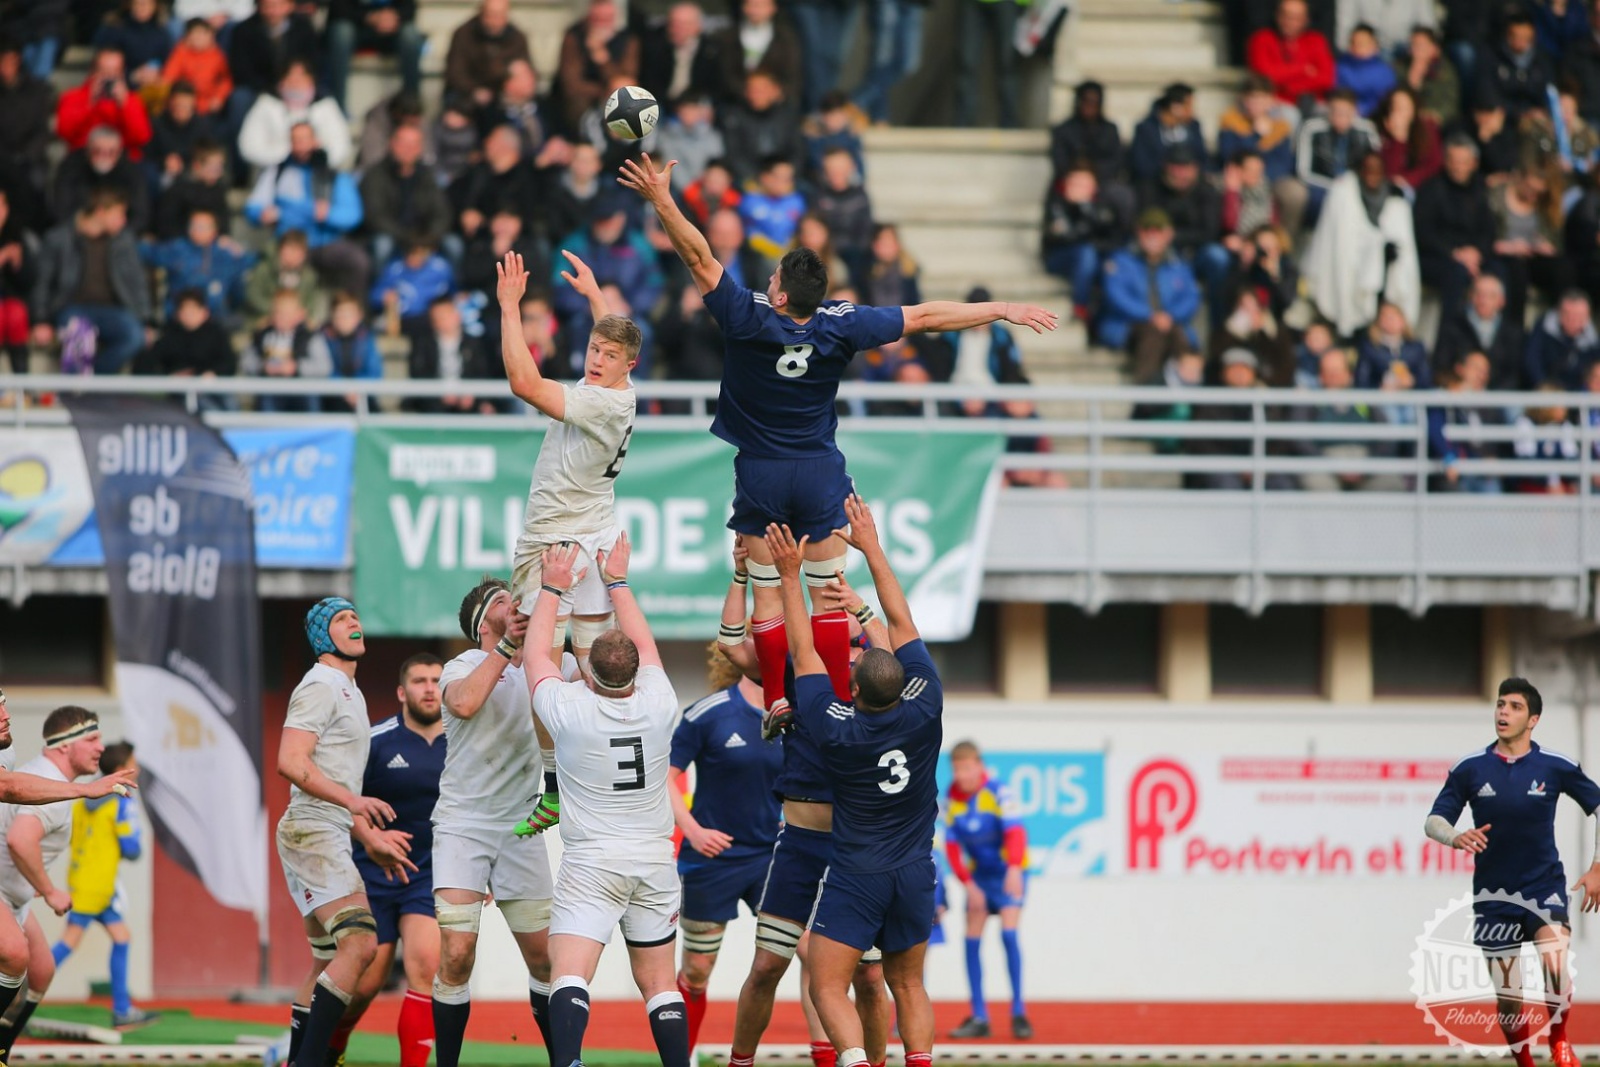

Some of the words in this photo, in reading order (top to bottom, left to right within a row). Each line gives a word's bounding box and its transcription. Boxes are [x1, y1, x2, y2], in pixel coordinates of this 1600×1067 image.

[775, 343, 814, 378] 8
[616, 496, 709, 571] DE
[609, 736, 646, 791] 3
[877, 749, 911, 794] 3
[1004, 764, 1088, 817] OIS
[1185, 836, 1353, 874] Portevin
